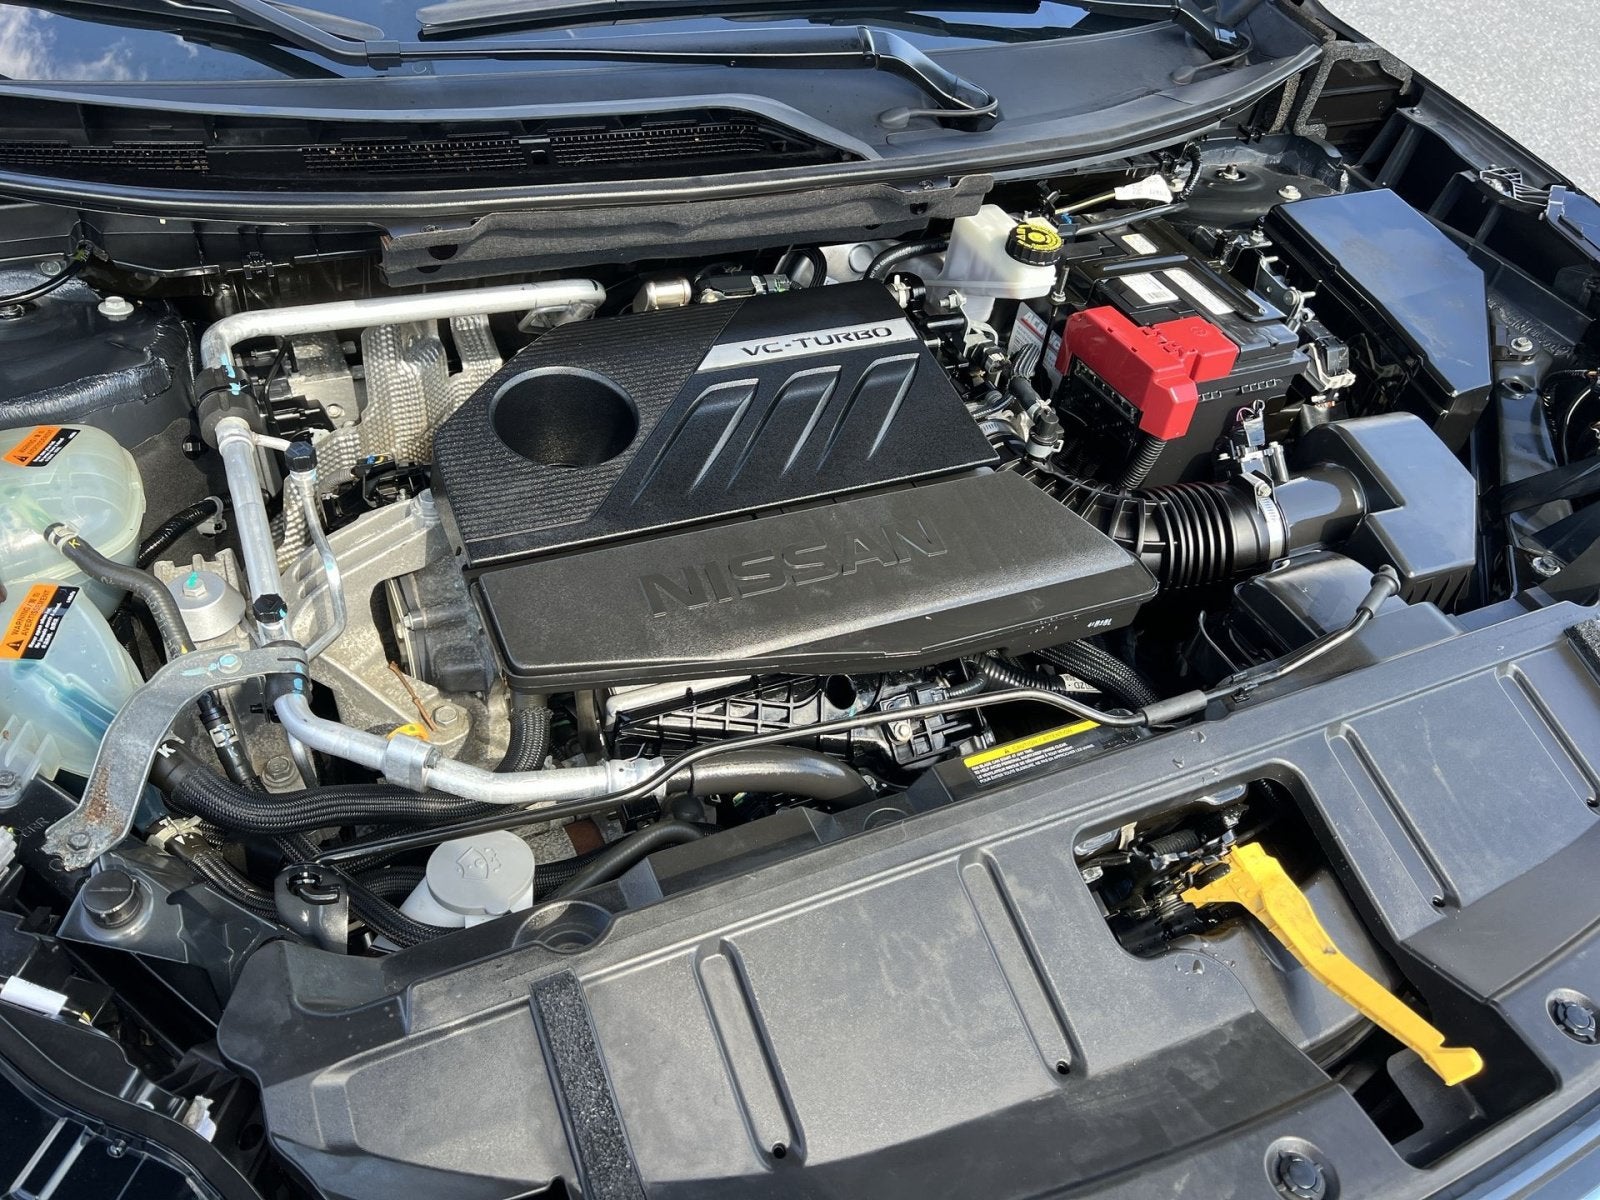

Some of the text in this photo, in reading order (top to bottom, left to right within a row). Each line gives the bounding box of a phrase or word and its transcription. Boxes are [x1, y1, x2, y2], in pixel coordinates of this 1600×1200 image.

[741, 326, 893, 356] VC-TURBO
[640, 519, 947, 618] NISSAN
[157, 743, 176, 758] K
